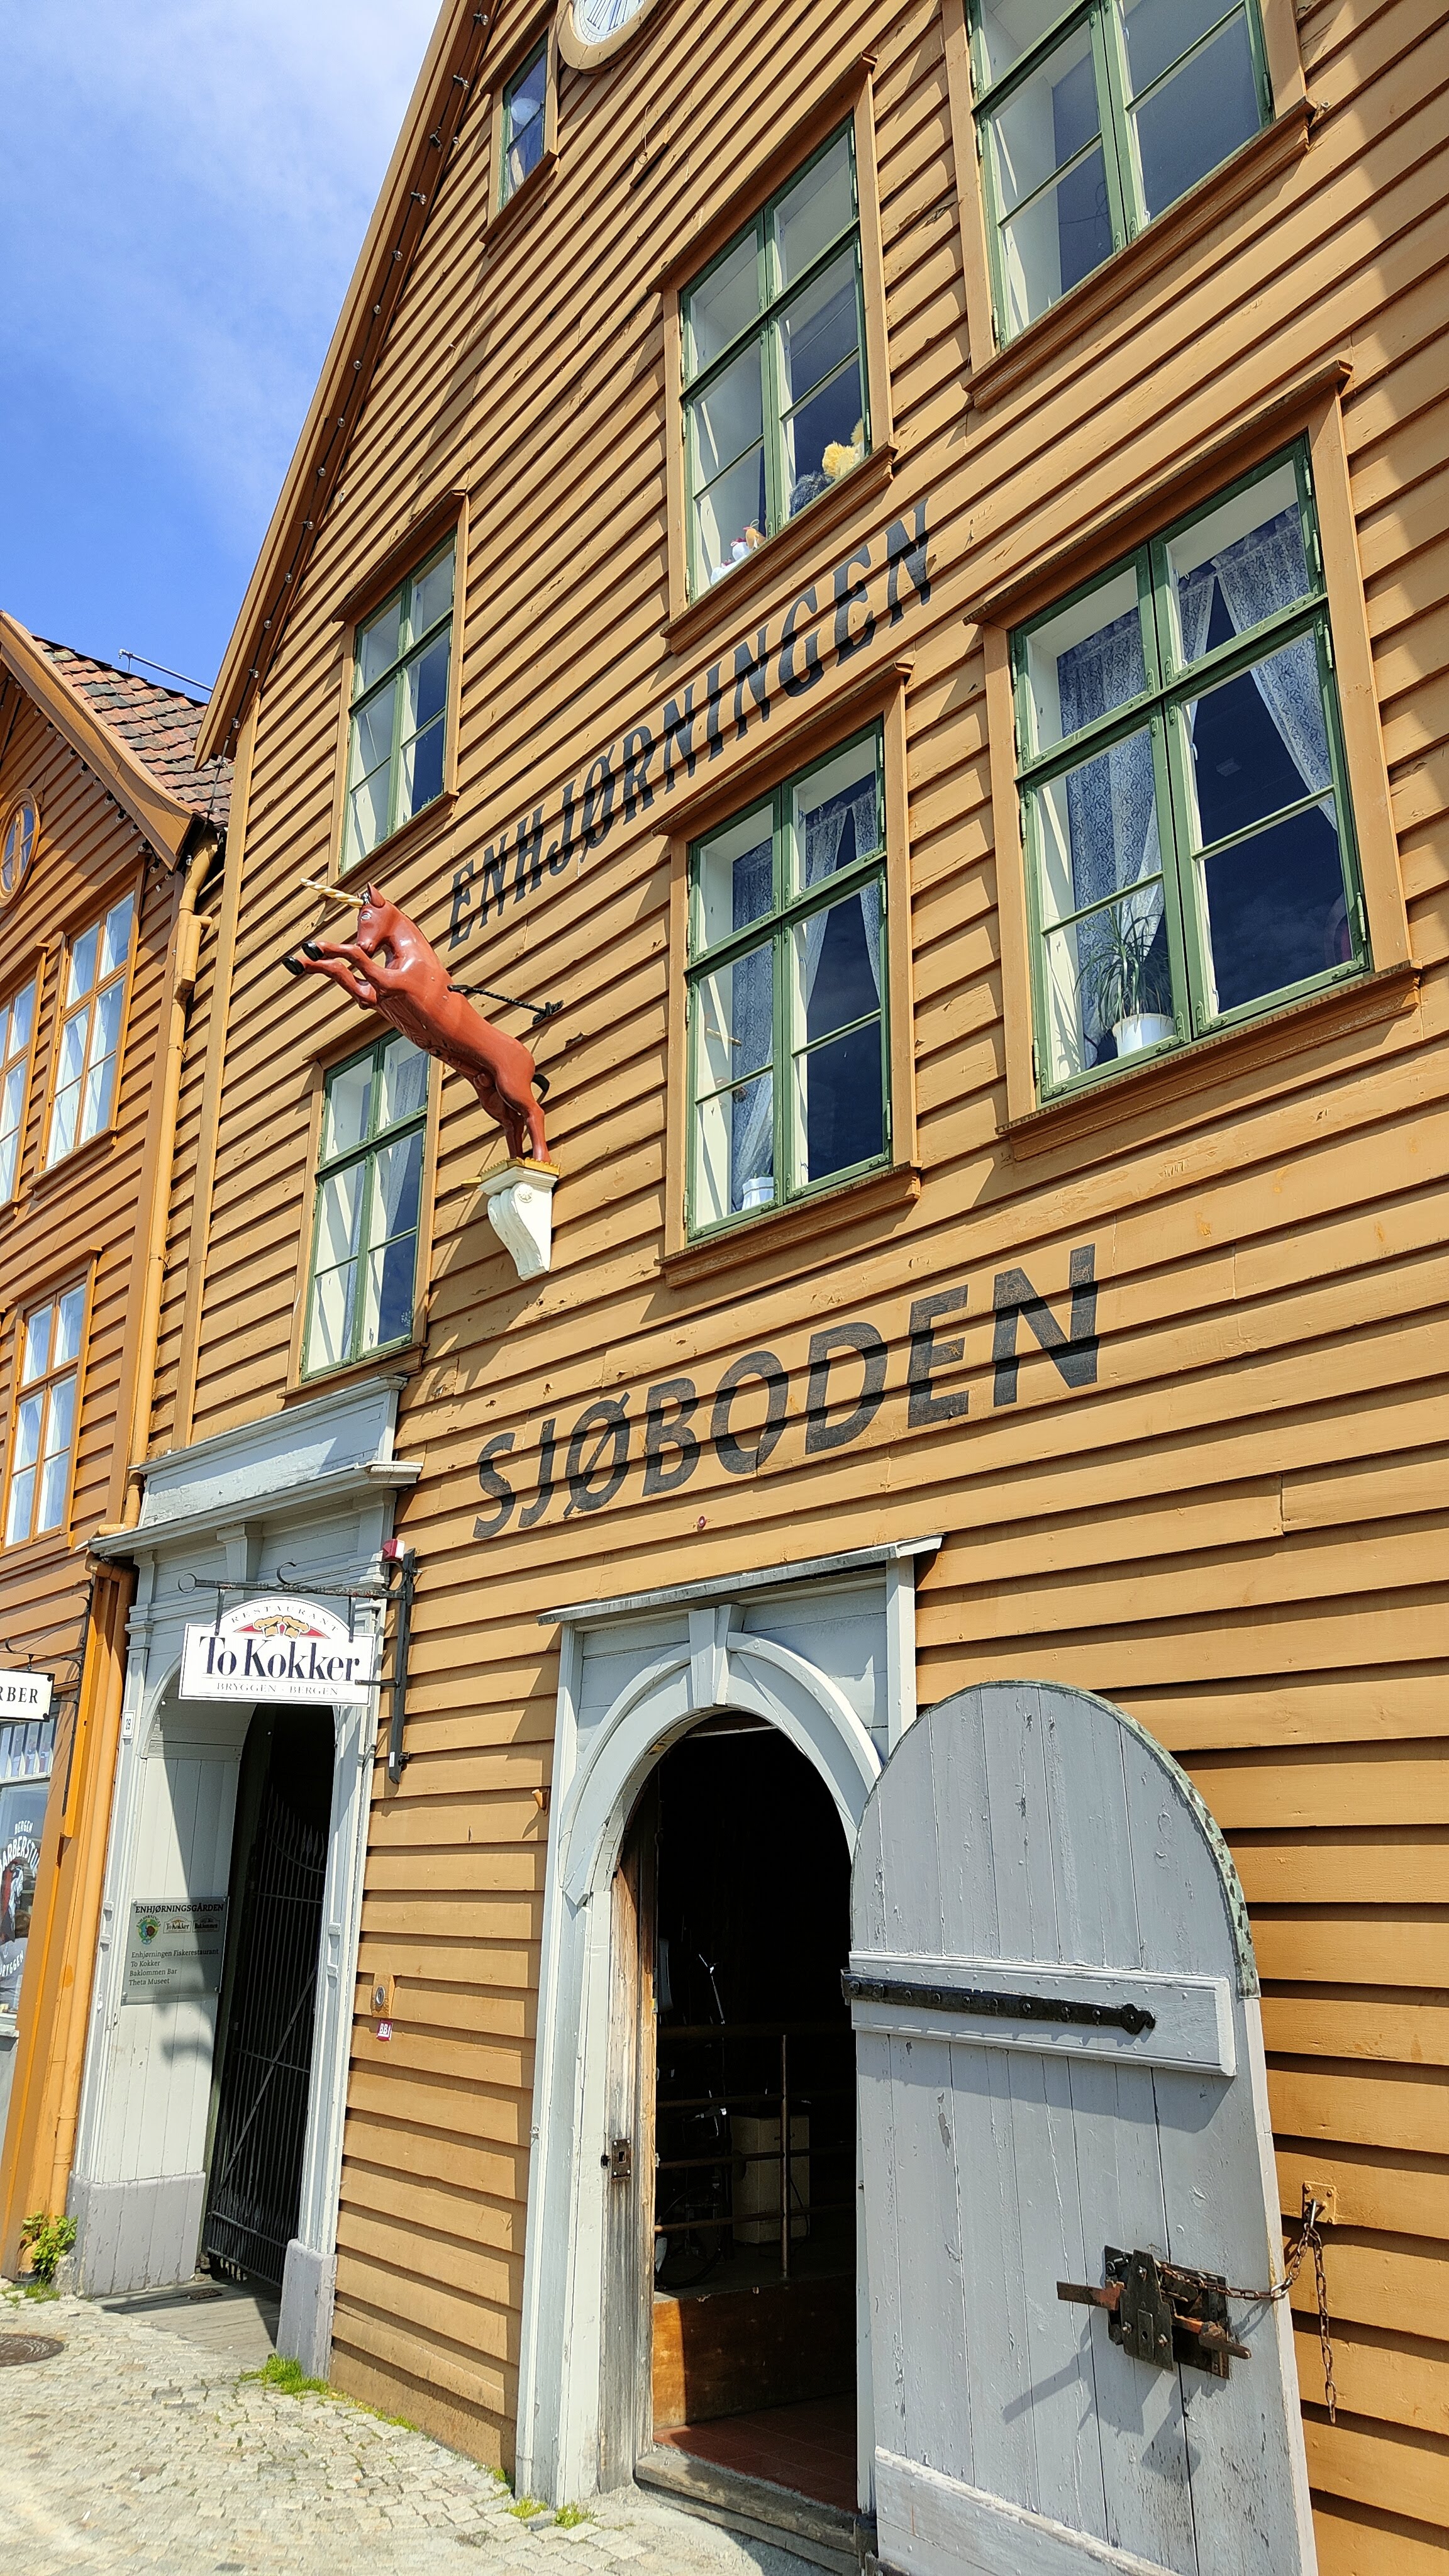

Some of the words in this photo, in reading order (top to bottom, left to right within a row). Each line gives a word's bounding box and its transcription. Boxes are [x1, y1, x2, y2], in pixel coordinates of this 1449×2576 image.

[448, 498, 931, 951] ENHJØRNINGEN
[472, 1243, 1100, 1538] SJØBODEN
[231, 1606, 338, 1632] RESTAURANT
[199, 1636, 237, 1675] To
[241, 1638, 360, 1682] Kokker
[217, 1682, 277, 1693] BRYGGEN
[290, 1686, 338, 1696] BERGEN
[14, 1820, 33, 1835] BERGEN
[135, 1903, 225, 1914] ENHJØRNINGSGÅRDEN
[131, 1951, 172, 1959] Enhjørningen
[174, 1948, 219, 1957] Fiskerestaurant
